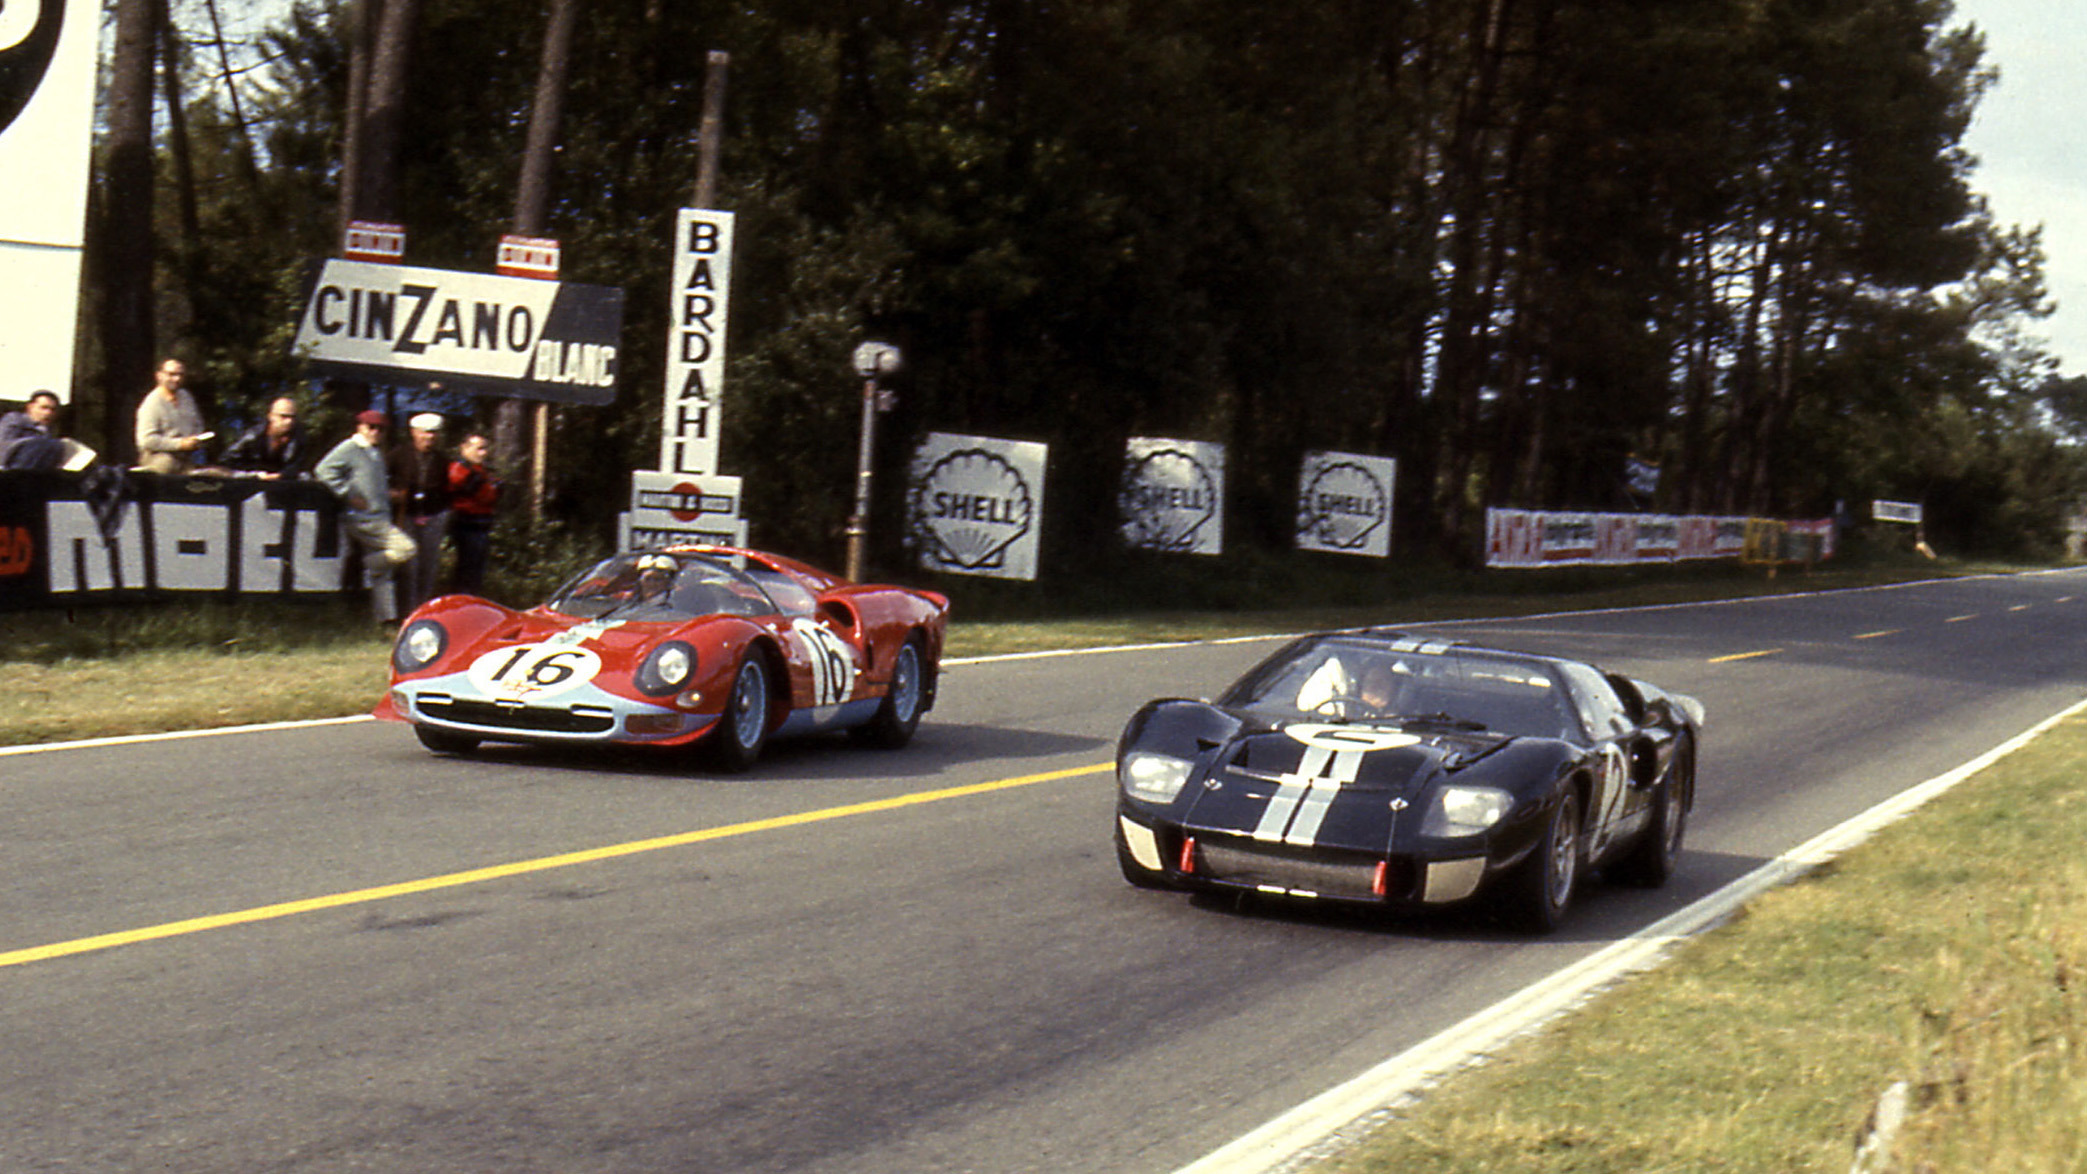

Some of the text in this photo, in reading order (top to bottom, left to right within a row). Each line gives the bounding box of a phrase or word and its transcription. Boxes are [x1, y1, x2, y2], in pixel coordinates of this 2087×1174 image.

[314, 284, 533, 354] CINZANO
[534, 340, 617, 387] BLANC
[674, 221, 719, 474] BARDAHL
[935, 491, 1016, 524] SHELL
[1319, 494, 1375, 517] SHELL
[490, 648, 585, 685] 16
[799, 628, 846, 706] 16
